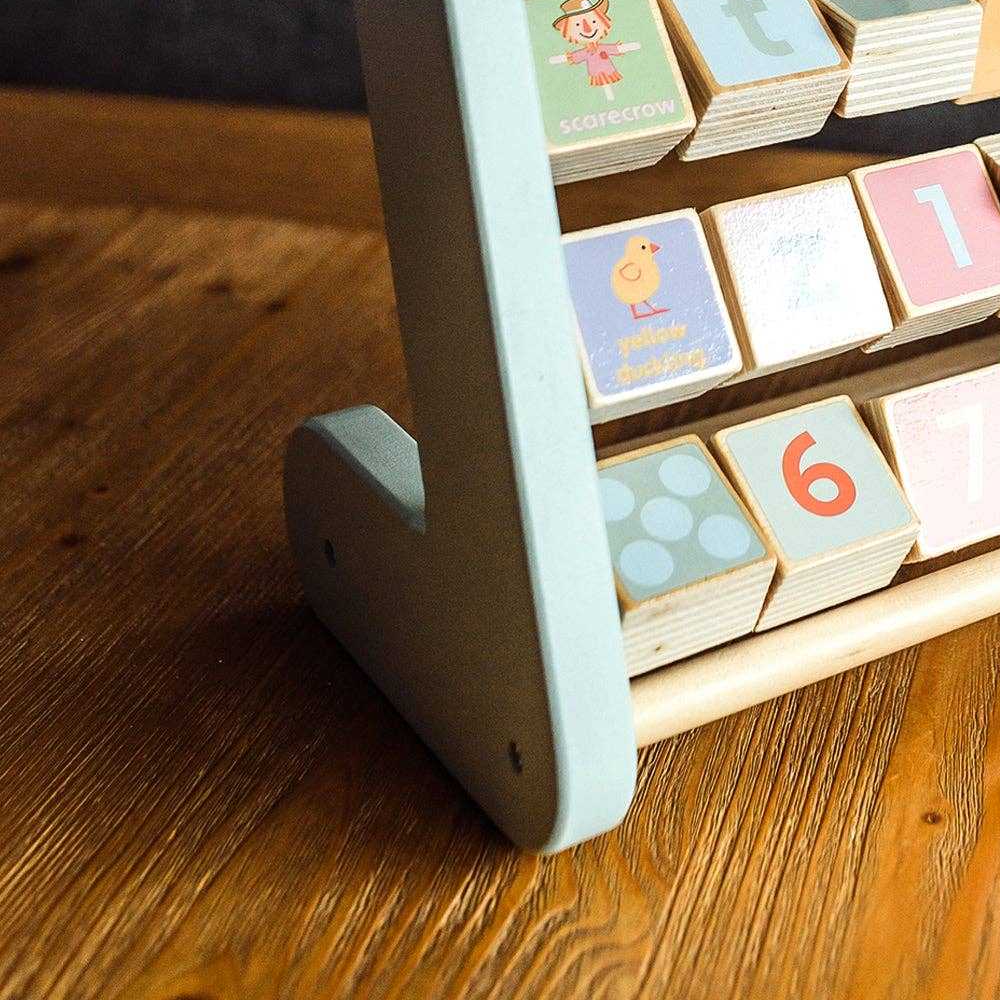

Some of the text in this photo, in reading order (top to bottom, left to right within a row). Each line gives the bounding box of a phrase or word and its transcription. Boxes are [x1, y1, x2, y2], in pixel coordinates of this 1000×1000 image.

[559, 99, 676, 135] scarecrow
[913, 183, 974, 269] 1
[782, 430, 856, 517] 6
[936, 402, 985, 503] 7
